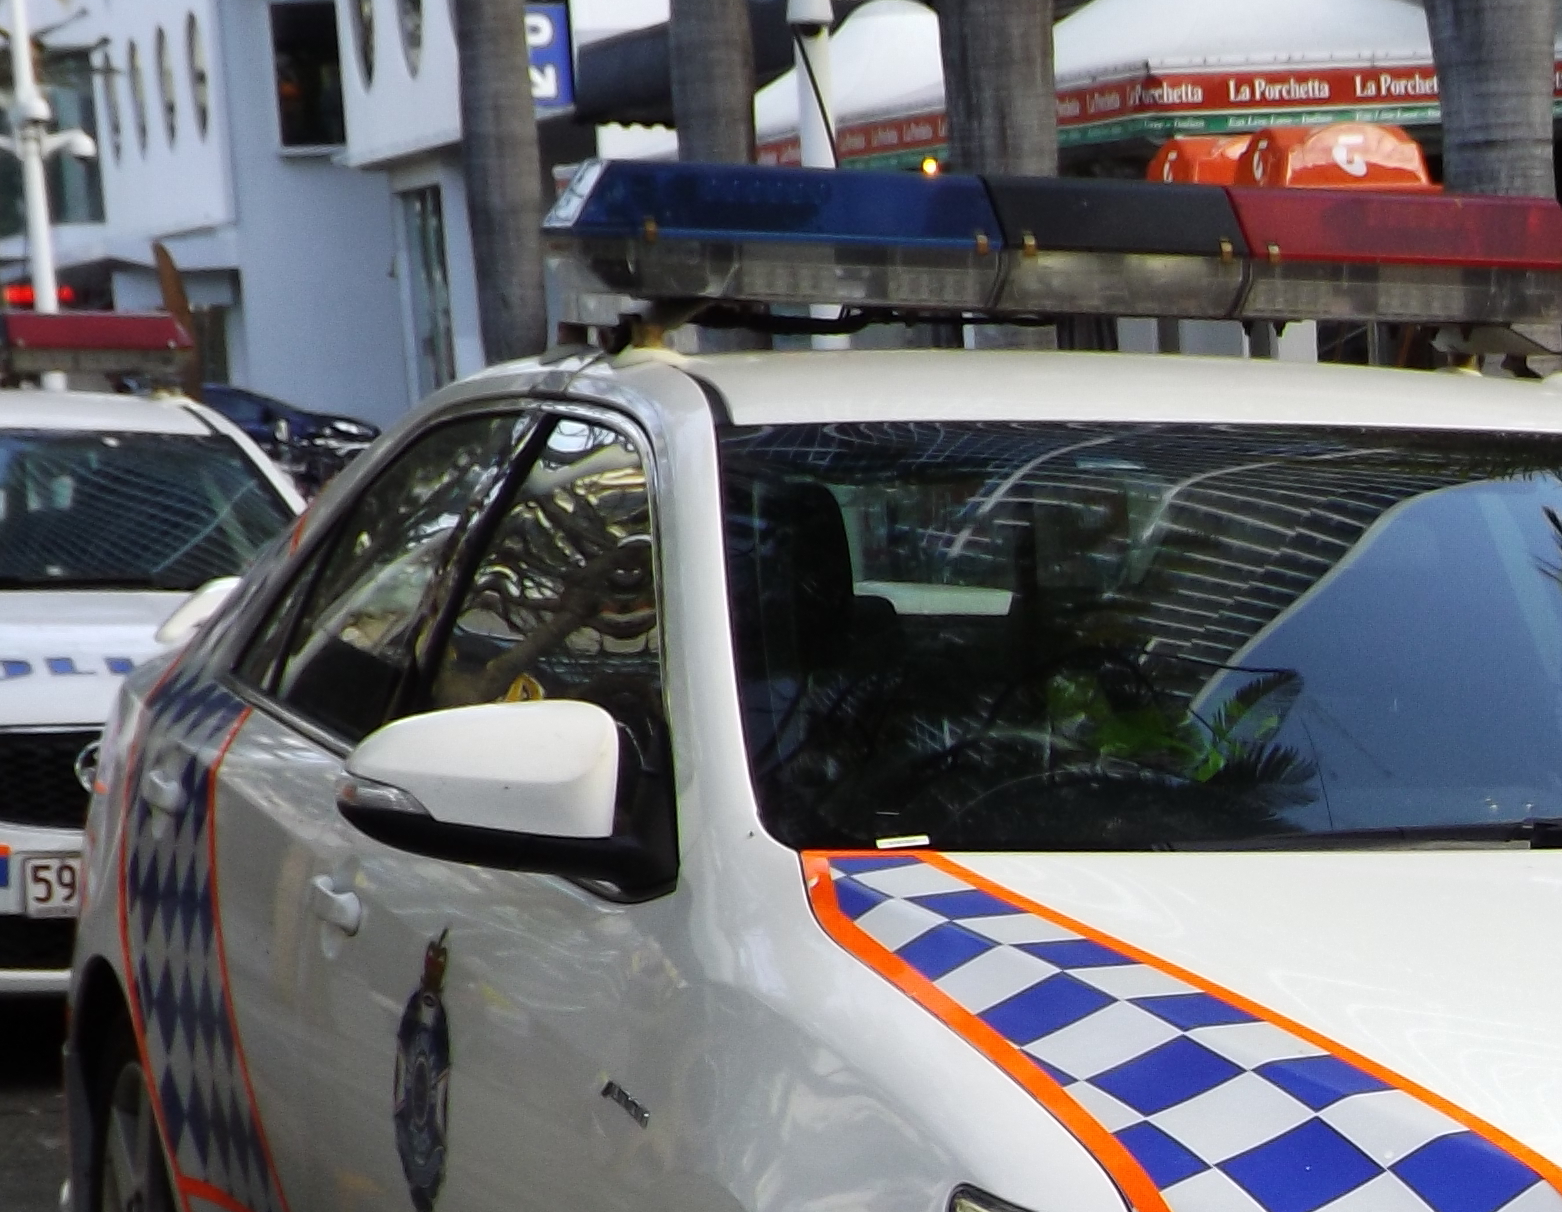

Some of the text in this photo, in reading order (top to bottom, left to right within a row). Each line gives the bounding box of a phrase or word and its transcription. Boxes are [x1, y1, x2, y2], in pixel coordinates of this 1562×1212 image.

[1228, 77, 1330, 103] La Porchetta
[1355, 74, 1376, 98] La
